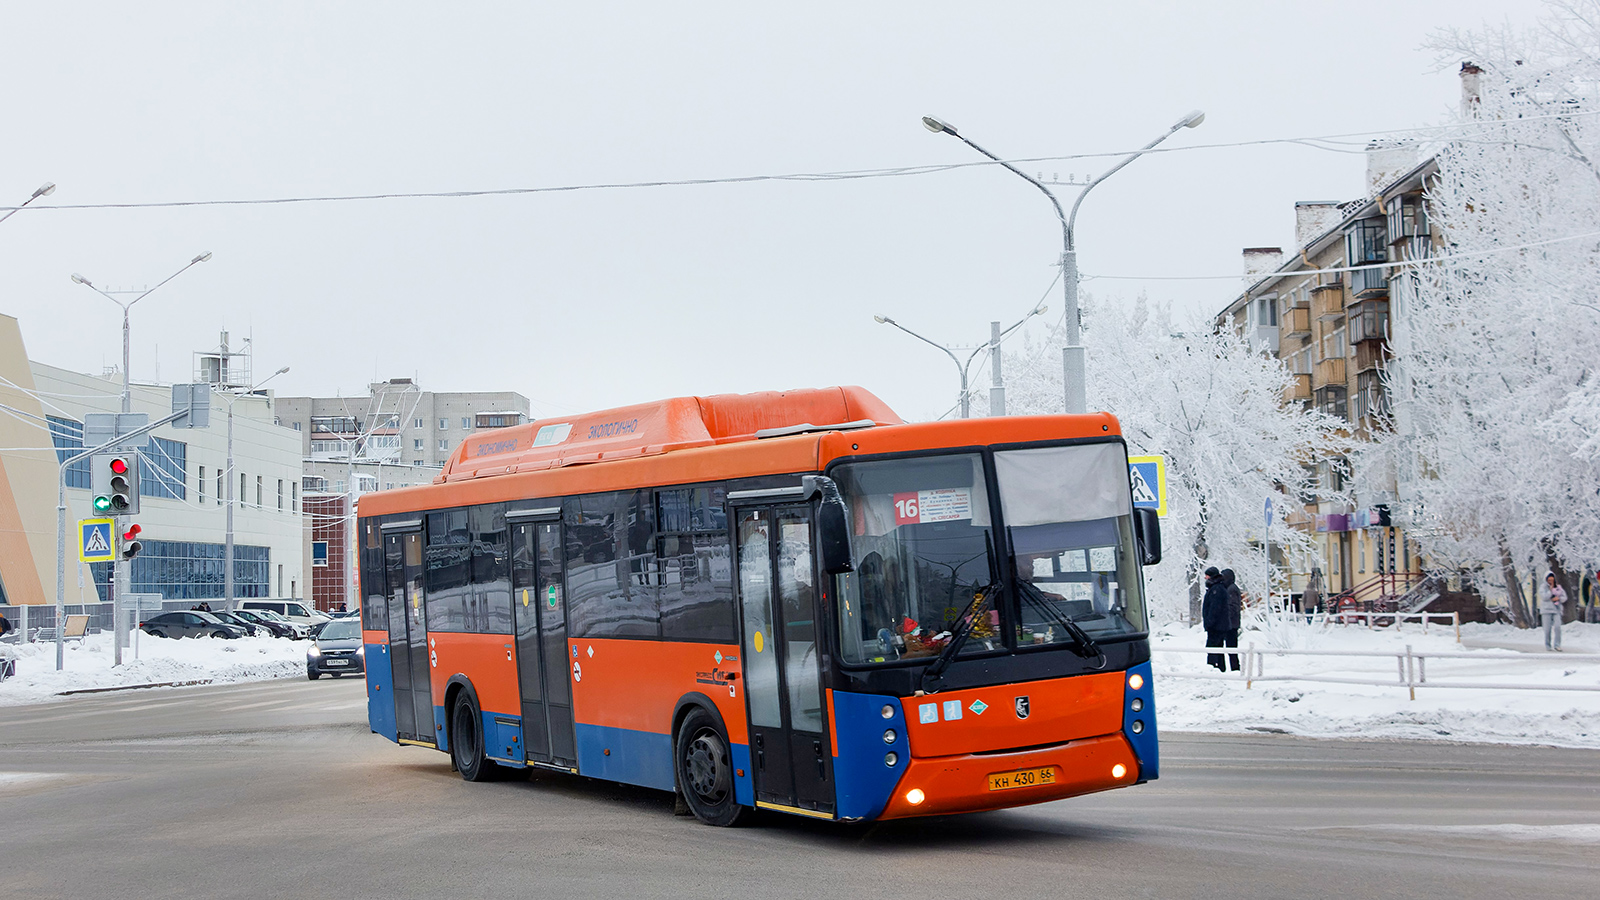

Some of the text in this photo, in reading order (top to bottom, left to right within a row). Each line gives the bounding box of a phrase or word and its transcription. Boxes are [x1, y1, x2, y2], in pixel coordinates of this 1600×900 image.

[588, 418, 638, 439] ЭКОЛОГИЧНО
[476, 438, 518, 457] ЭКОНОМИЧНО
[895, 498, 918, 518] 16
[994, 769, 1052, 788] КН 430 66
